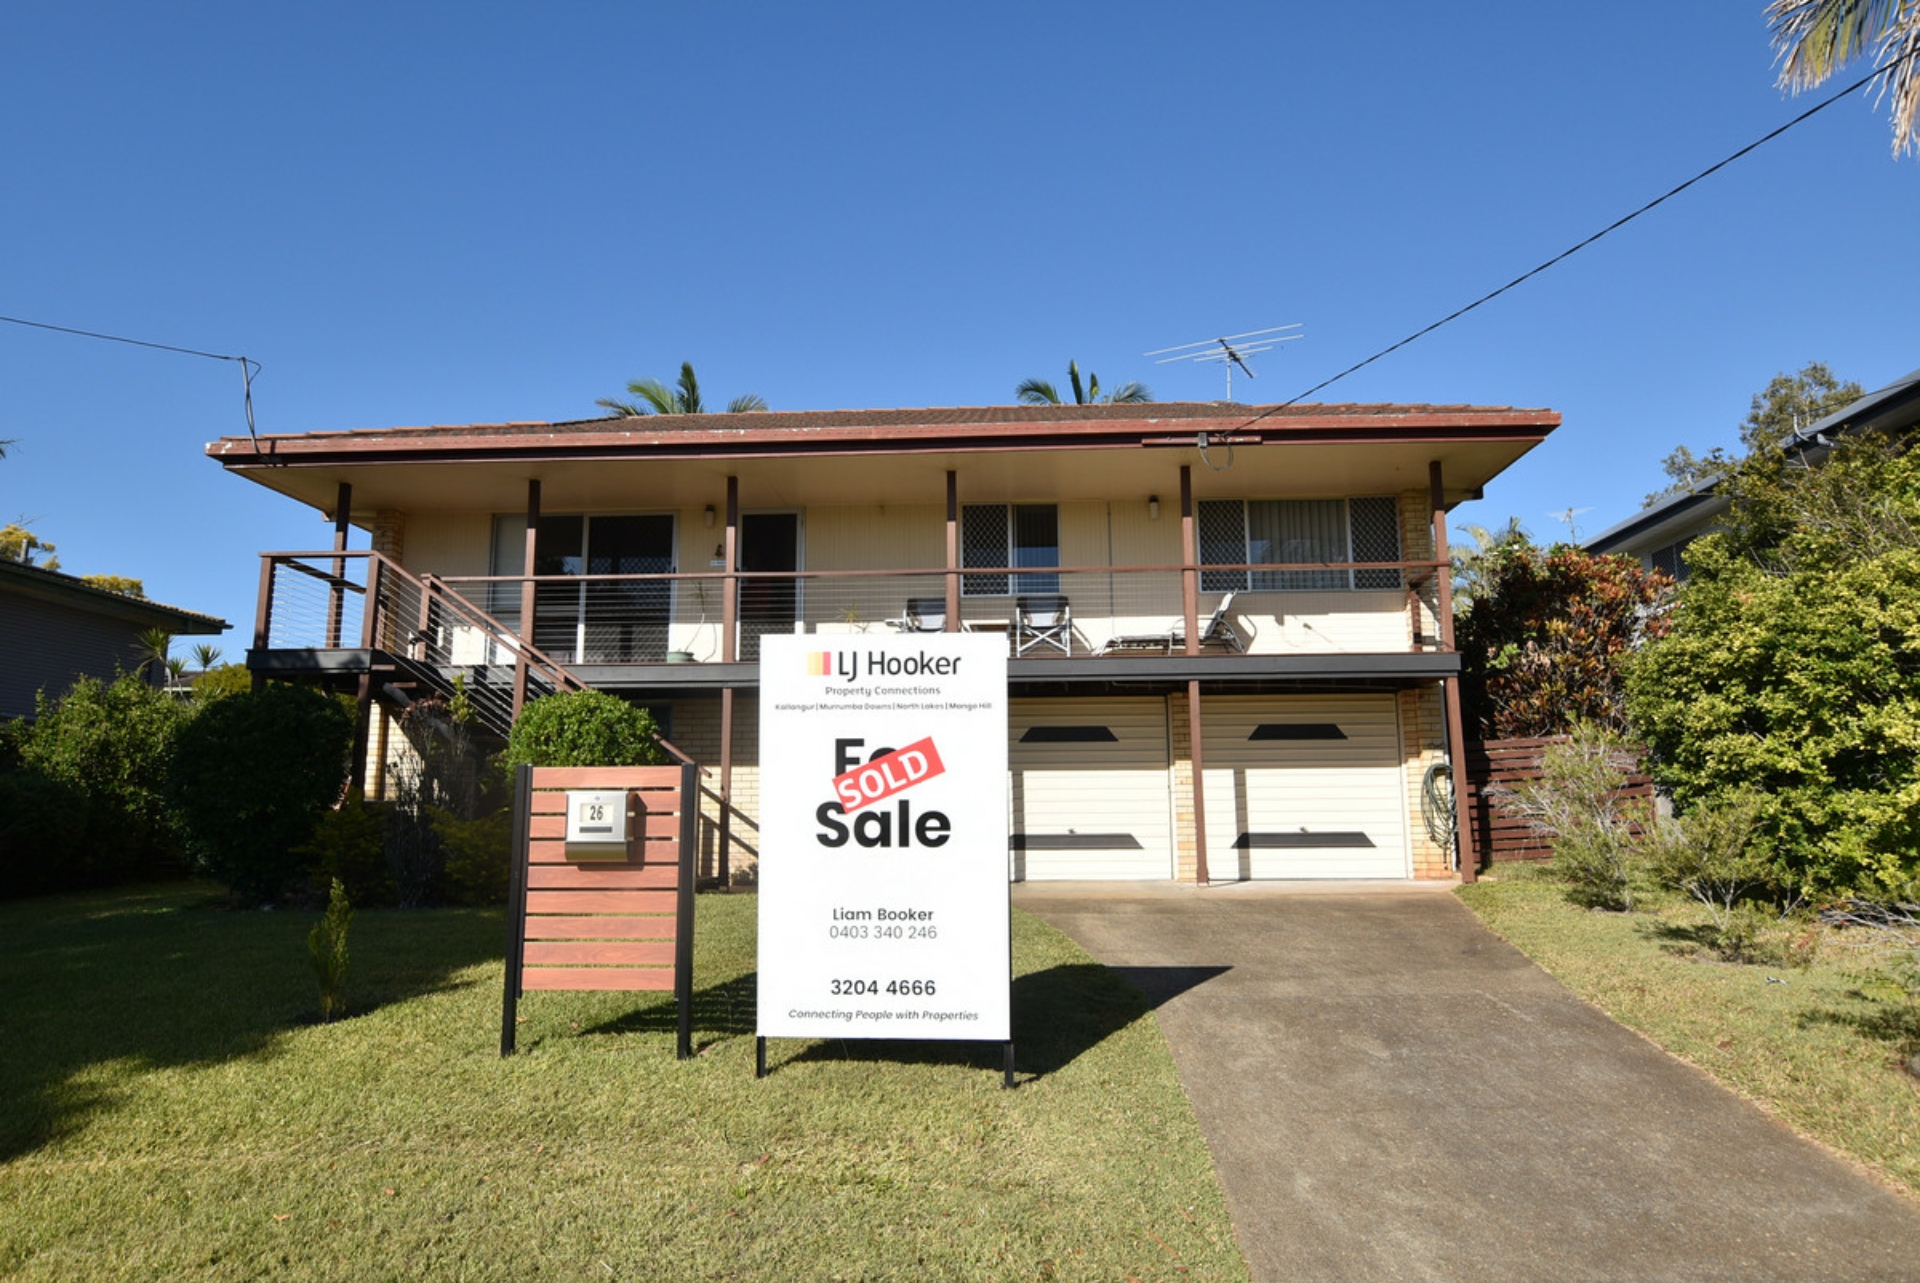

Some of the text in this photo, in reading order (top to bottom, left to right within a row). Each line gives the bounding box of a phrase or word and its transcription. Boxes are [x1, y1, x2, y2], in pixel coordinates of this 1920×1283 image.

[838, 650, 963, 683] LJ Hooker
[825, 686, 942, 697] Property Connections
[897, 702, 920, 711] North
[921, 702, 945, 711] Lakes
[949, 702, 978, 712] Mango
[837, 749, 929, 809] SOLD
[589, 804, 604, 822] 26
[815, 798, 952, 849] Sale
[833, 906, 935, 923] Liam Booker
[829, 925, 938, 941] 0403 340 246
[830, 978, 937, 997] 3204 4666
[788, 1008, 980, 1023] Connecting People with Properties
